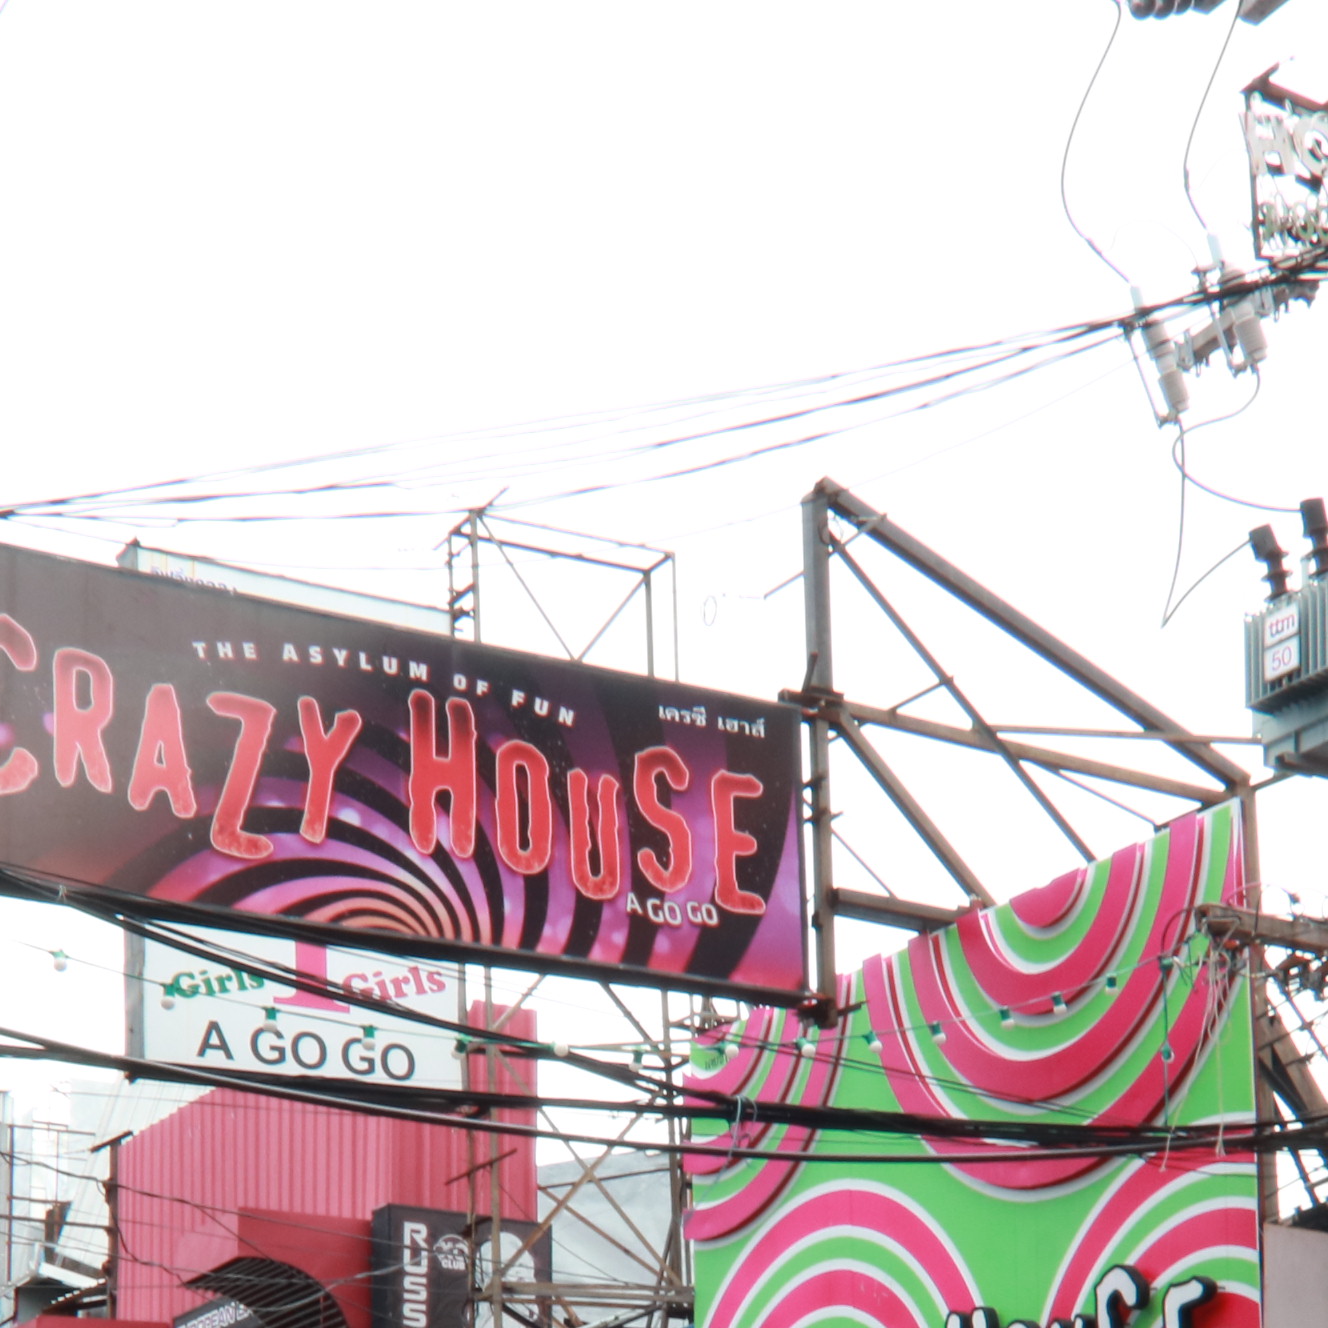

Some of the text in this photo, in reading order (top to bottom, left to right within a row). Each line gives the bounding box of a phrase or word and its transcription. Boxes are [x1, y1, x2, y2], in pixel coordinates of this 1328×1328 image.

[192, 640, 576, 727] THE ASYLUM OF FUN
[407, 688, 767, 914] HOUSE
[626, 892, 719, 926] A GO GO
[173, 967, 265, 1000] Girls
[342, 965, 447, 1002] Girls
[197, 1020, 416, 1081] A GO GO
